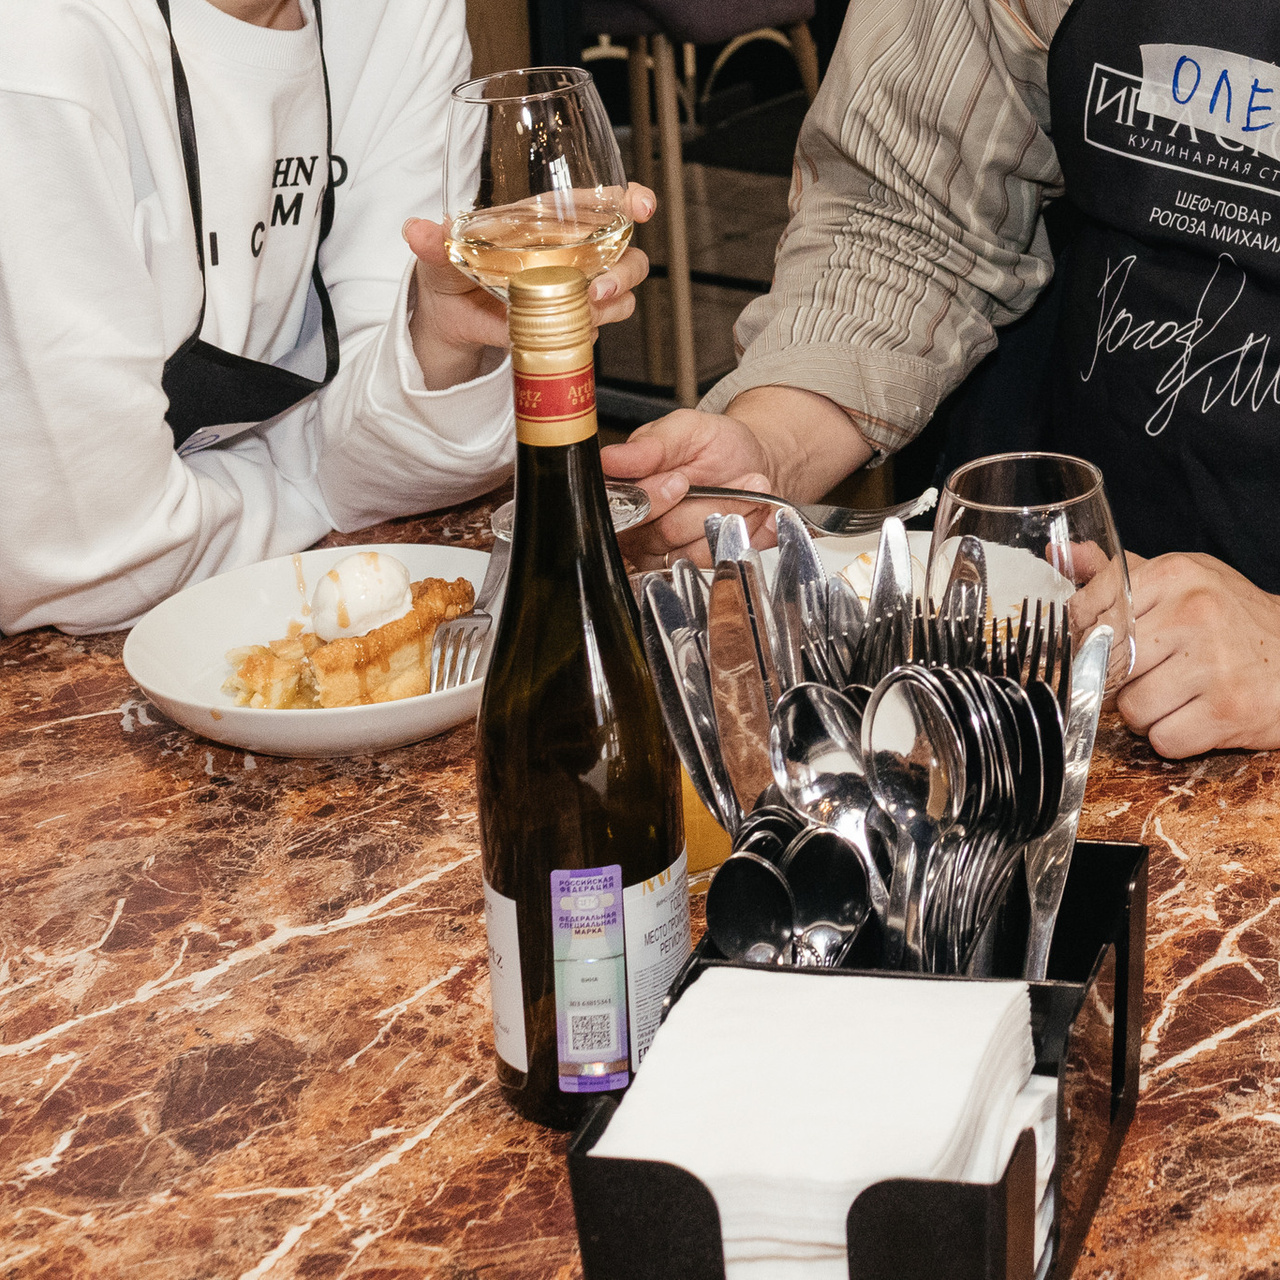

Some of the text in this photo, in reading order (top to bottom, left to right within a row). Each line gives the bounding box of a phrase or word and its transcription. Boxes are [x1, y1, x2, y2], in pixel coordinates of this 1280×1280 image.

[1128, 133, 1252, 176] КУЛИНАРНАЯ
[1174, 190, 1272, 227] ШЕФ-ПОВАР
[1149, 206, 1207, 237] РОГОЗА
[558, 875, 614, 887] РОССИЙСКАЯ
[559, 881, 615, 893] ФЕДЕРАЦИЯ
[574, 927, 603, 936] МАРКА
